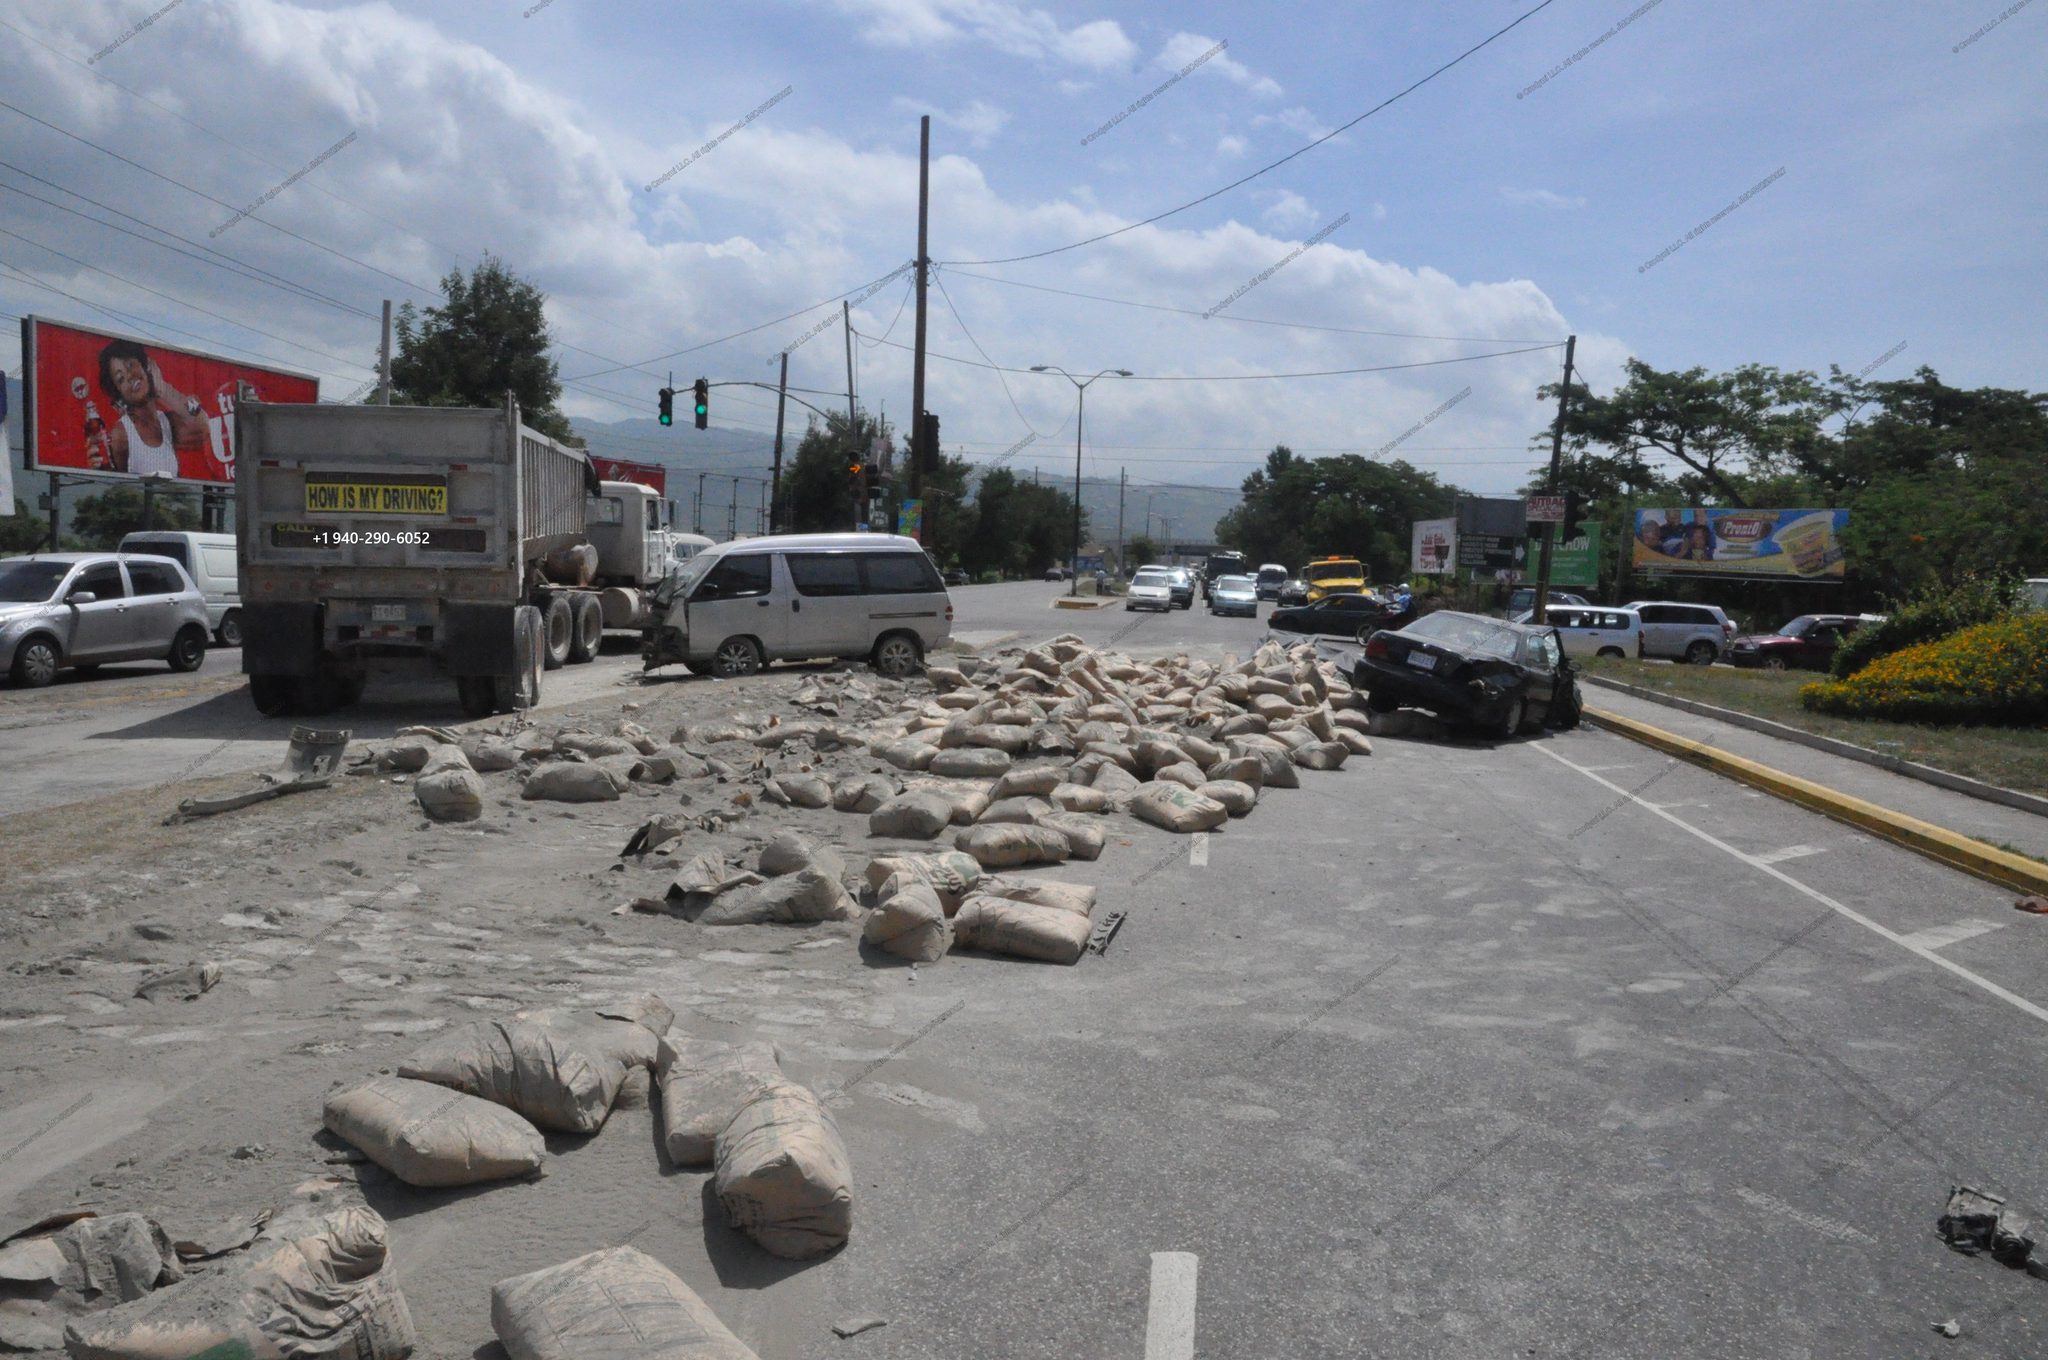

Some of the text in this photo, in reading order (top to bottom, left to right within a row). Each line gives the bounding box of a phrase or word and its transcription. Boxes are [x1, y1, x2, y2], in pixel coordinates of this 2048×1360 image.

[308, 486, 444, 510] HOW IS MY DRIVING?
